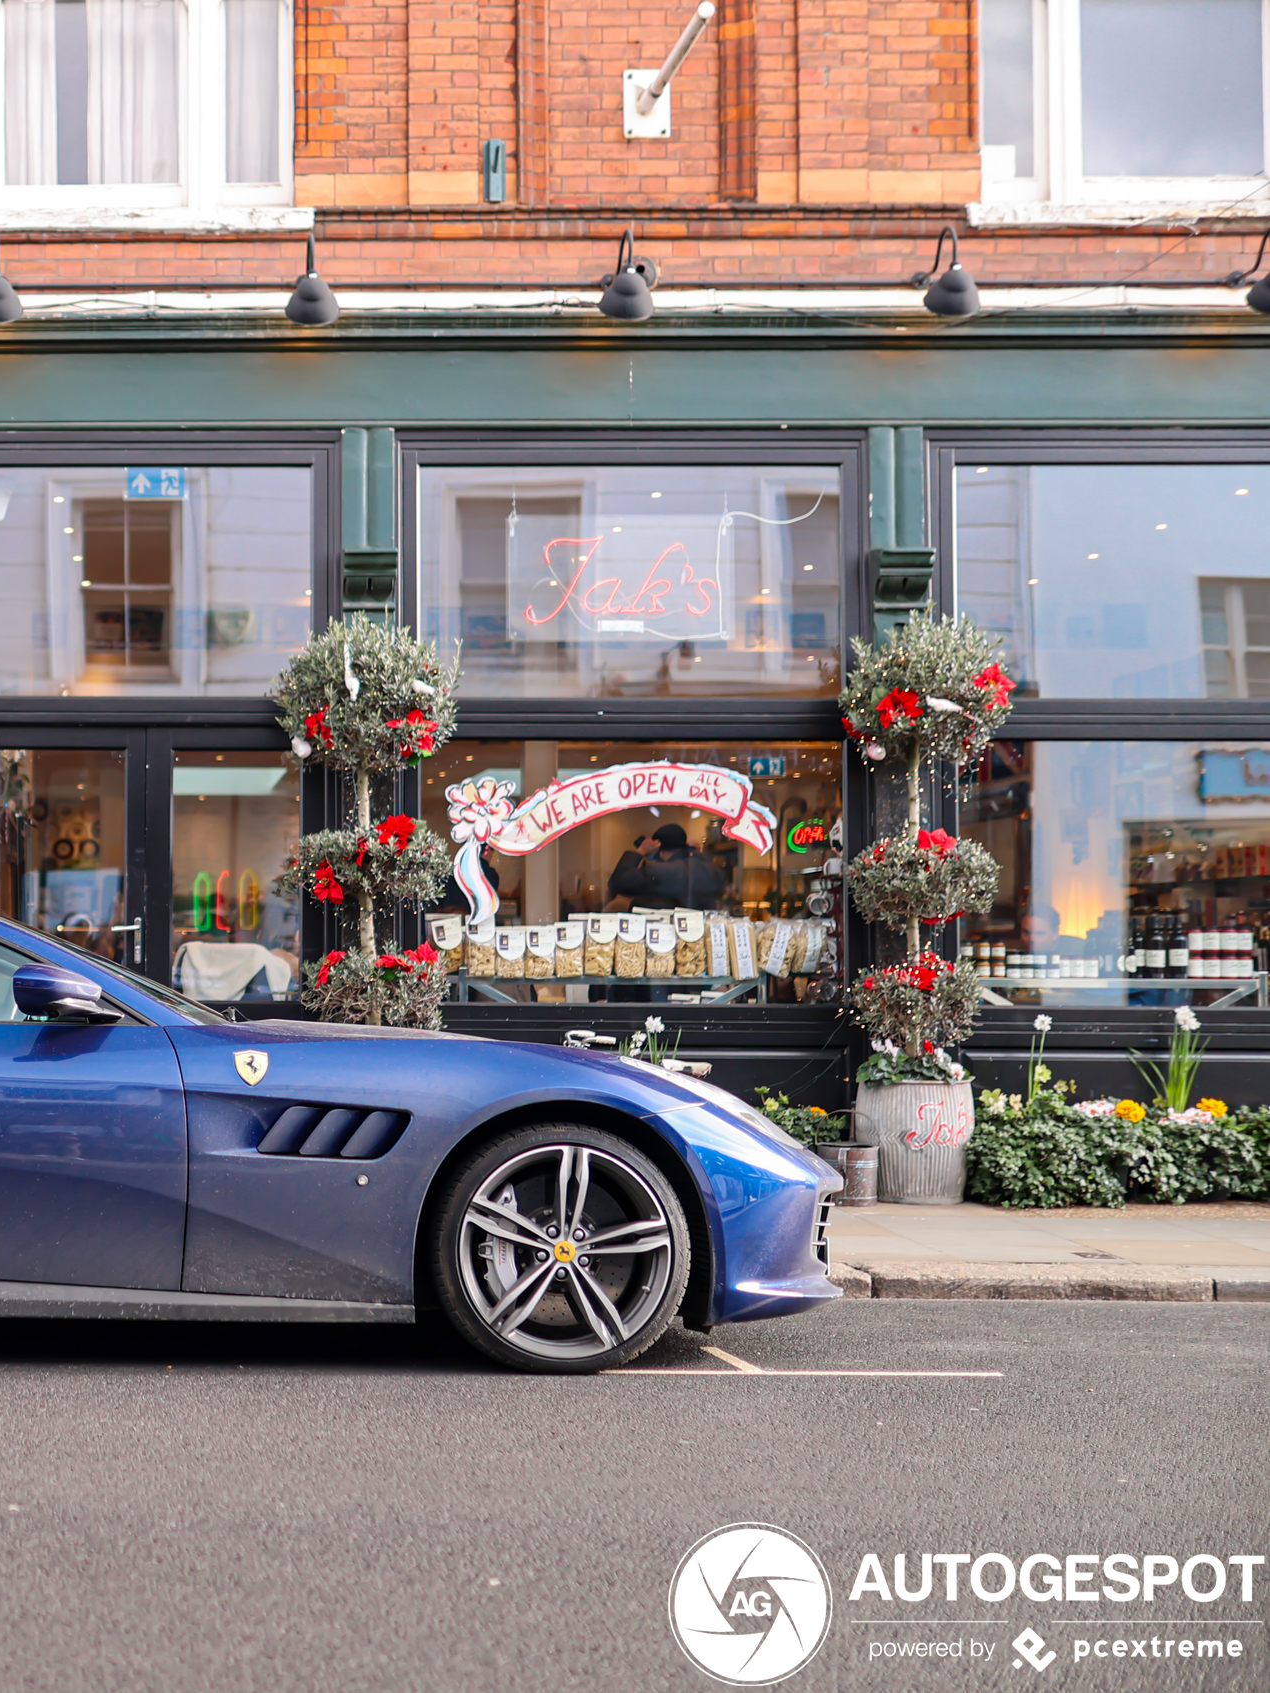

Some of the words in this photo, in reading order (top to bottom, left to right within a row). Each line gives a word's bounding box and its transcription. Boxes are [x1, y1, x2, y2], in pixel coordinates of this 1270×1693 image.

[524, 535, 718, 624] Jak's
[530, 799, 567, 833] WE
[572, 782, 610, 816] ARE
[618, 773, 677, 799] OPEN
[689, 784, 728, 804] DAY
[696, 773, 720, 787] ALL
[905, 1100, 975, 1149] Jak
